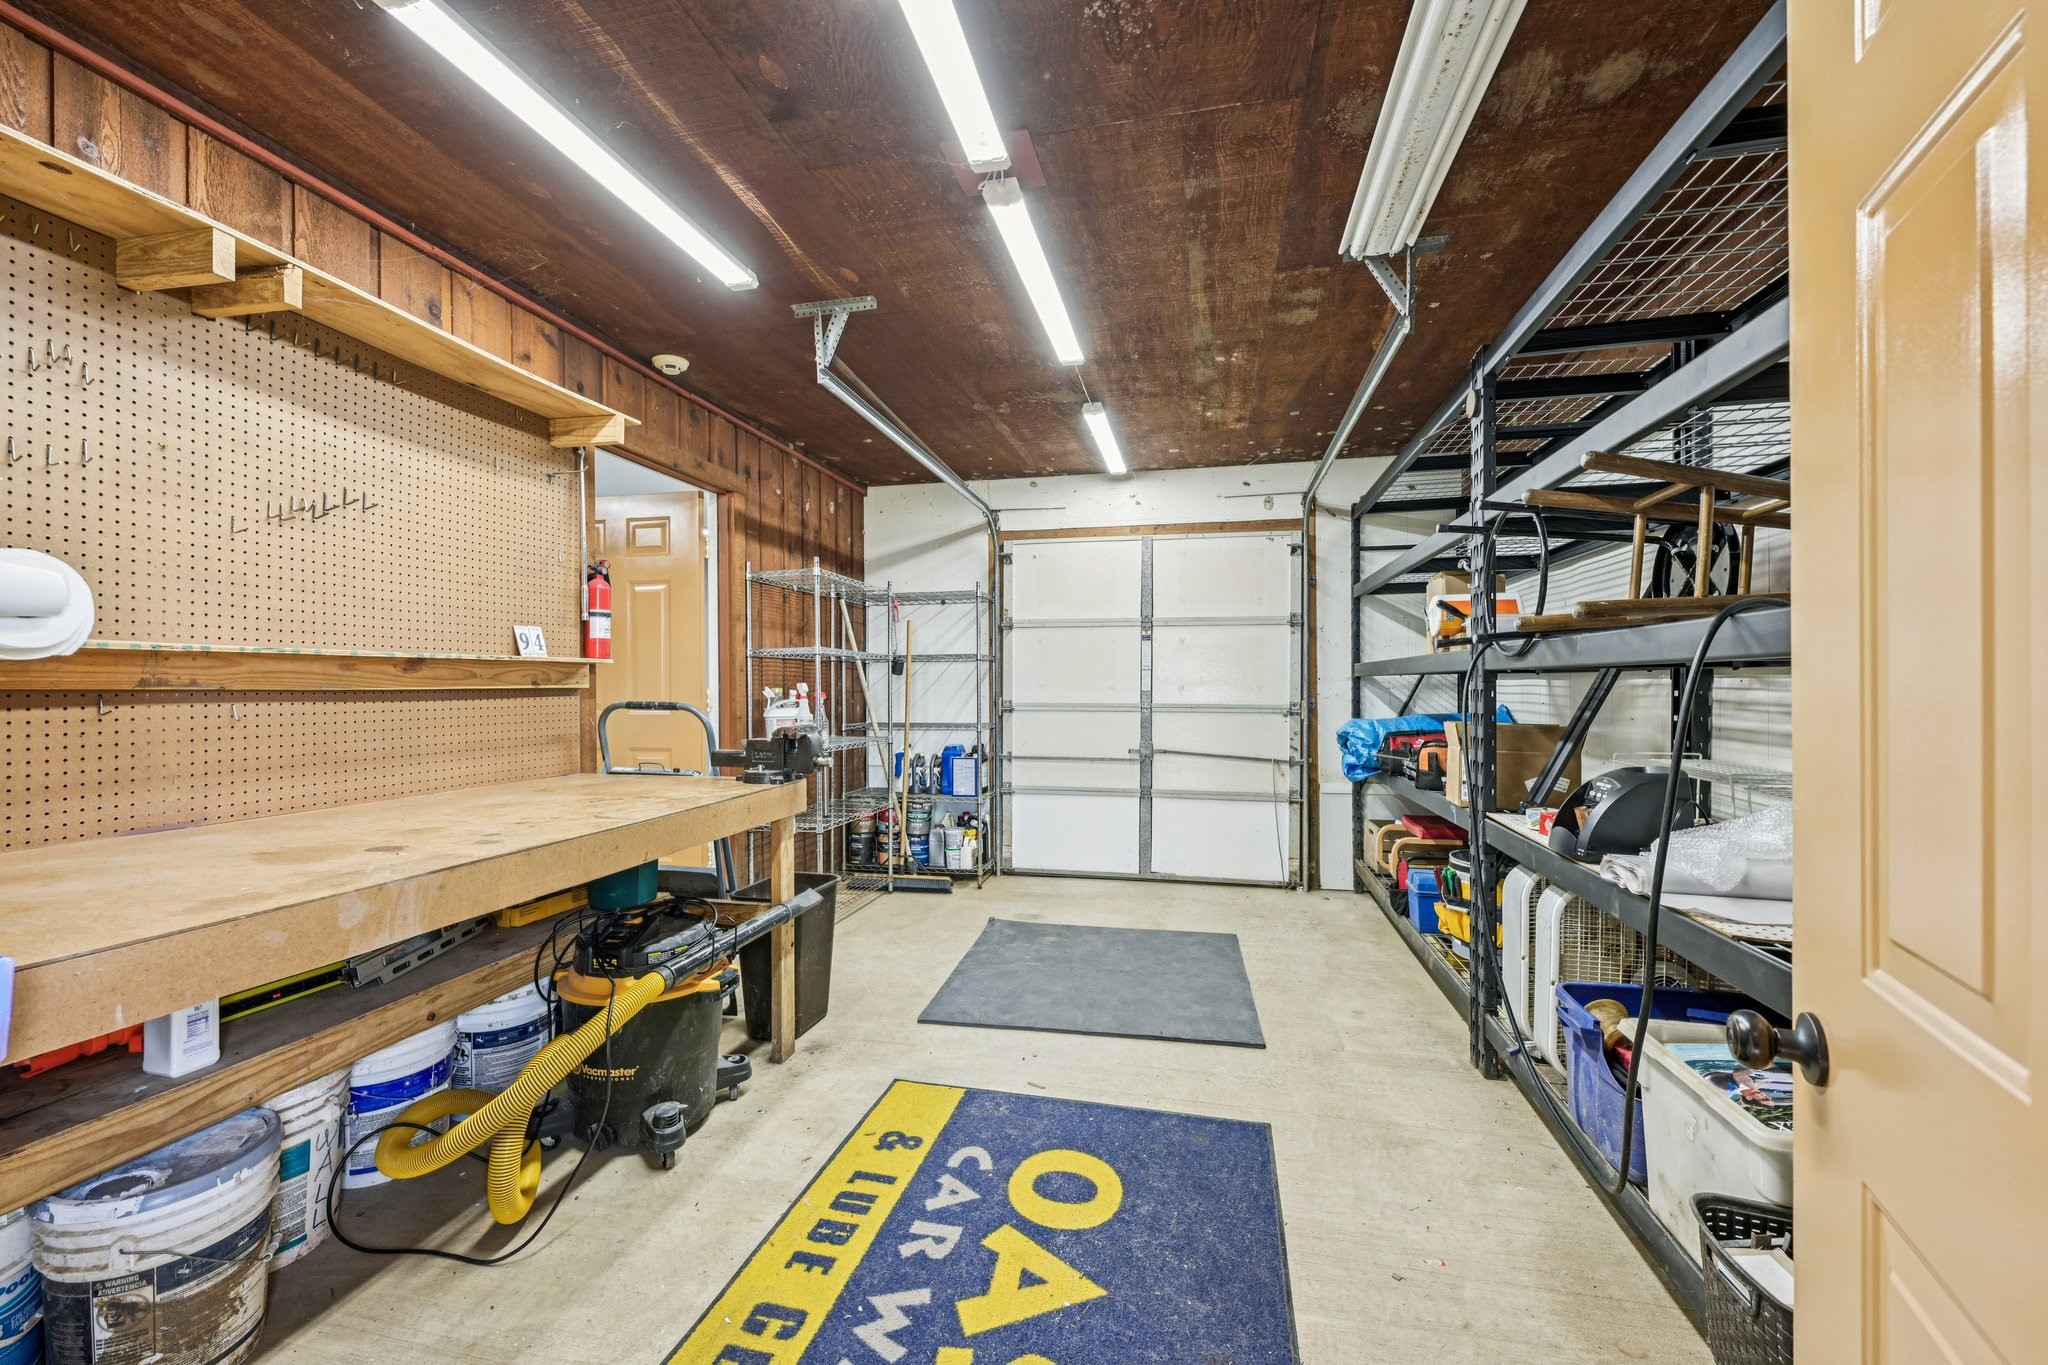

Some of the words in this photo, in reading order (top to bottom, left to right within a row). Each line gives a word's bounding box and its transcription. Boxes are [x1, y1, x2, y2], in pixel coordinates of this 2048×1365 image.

[872, 1130, 924, 1154] &
[784, 1170, 899, 1277] LUBE
[898, 1144, 993, 1262] CAR
[97, 1280, 148, 1297] ADVERTENCIA
[104, 1274, 140, 1288] WARNING
[837, 1288, 932, 1365] W
